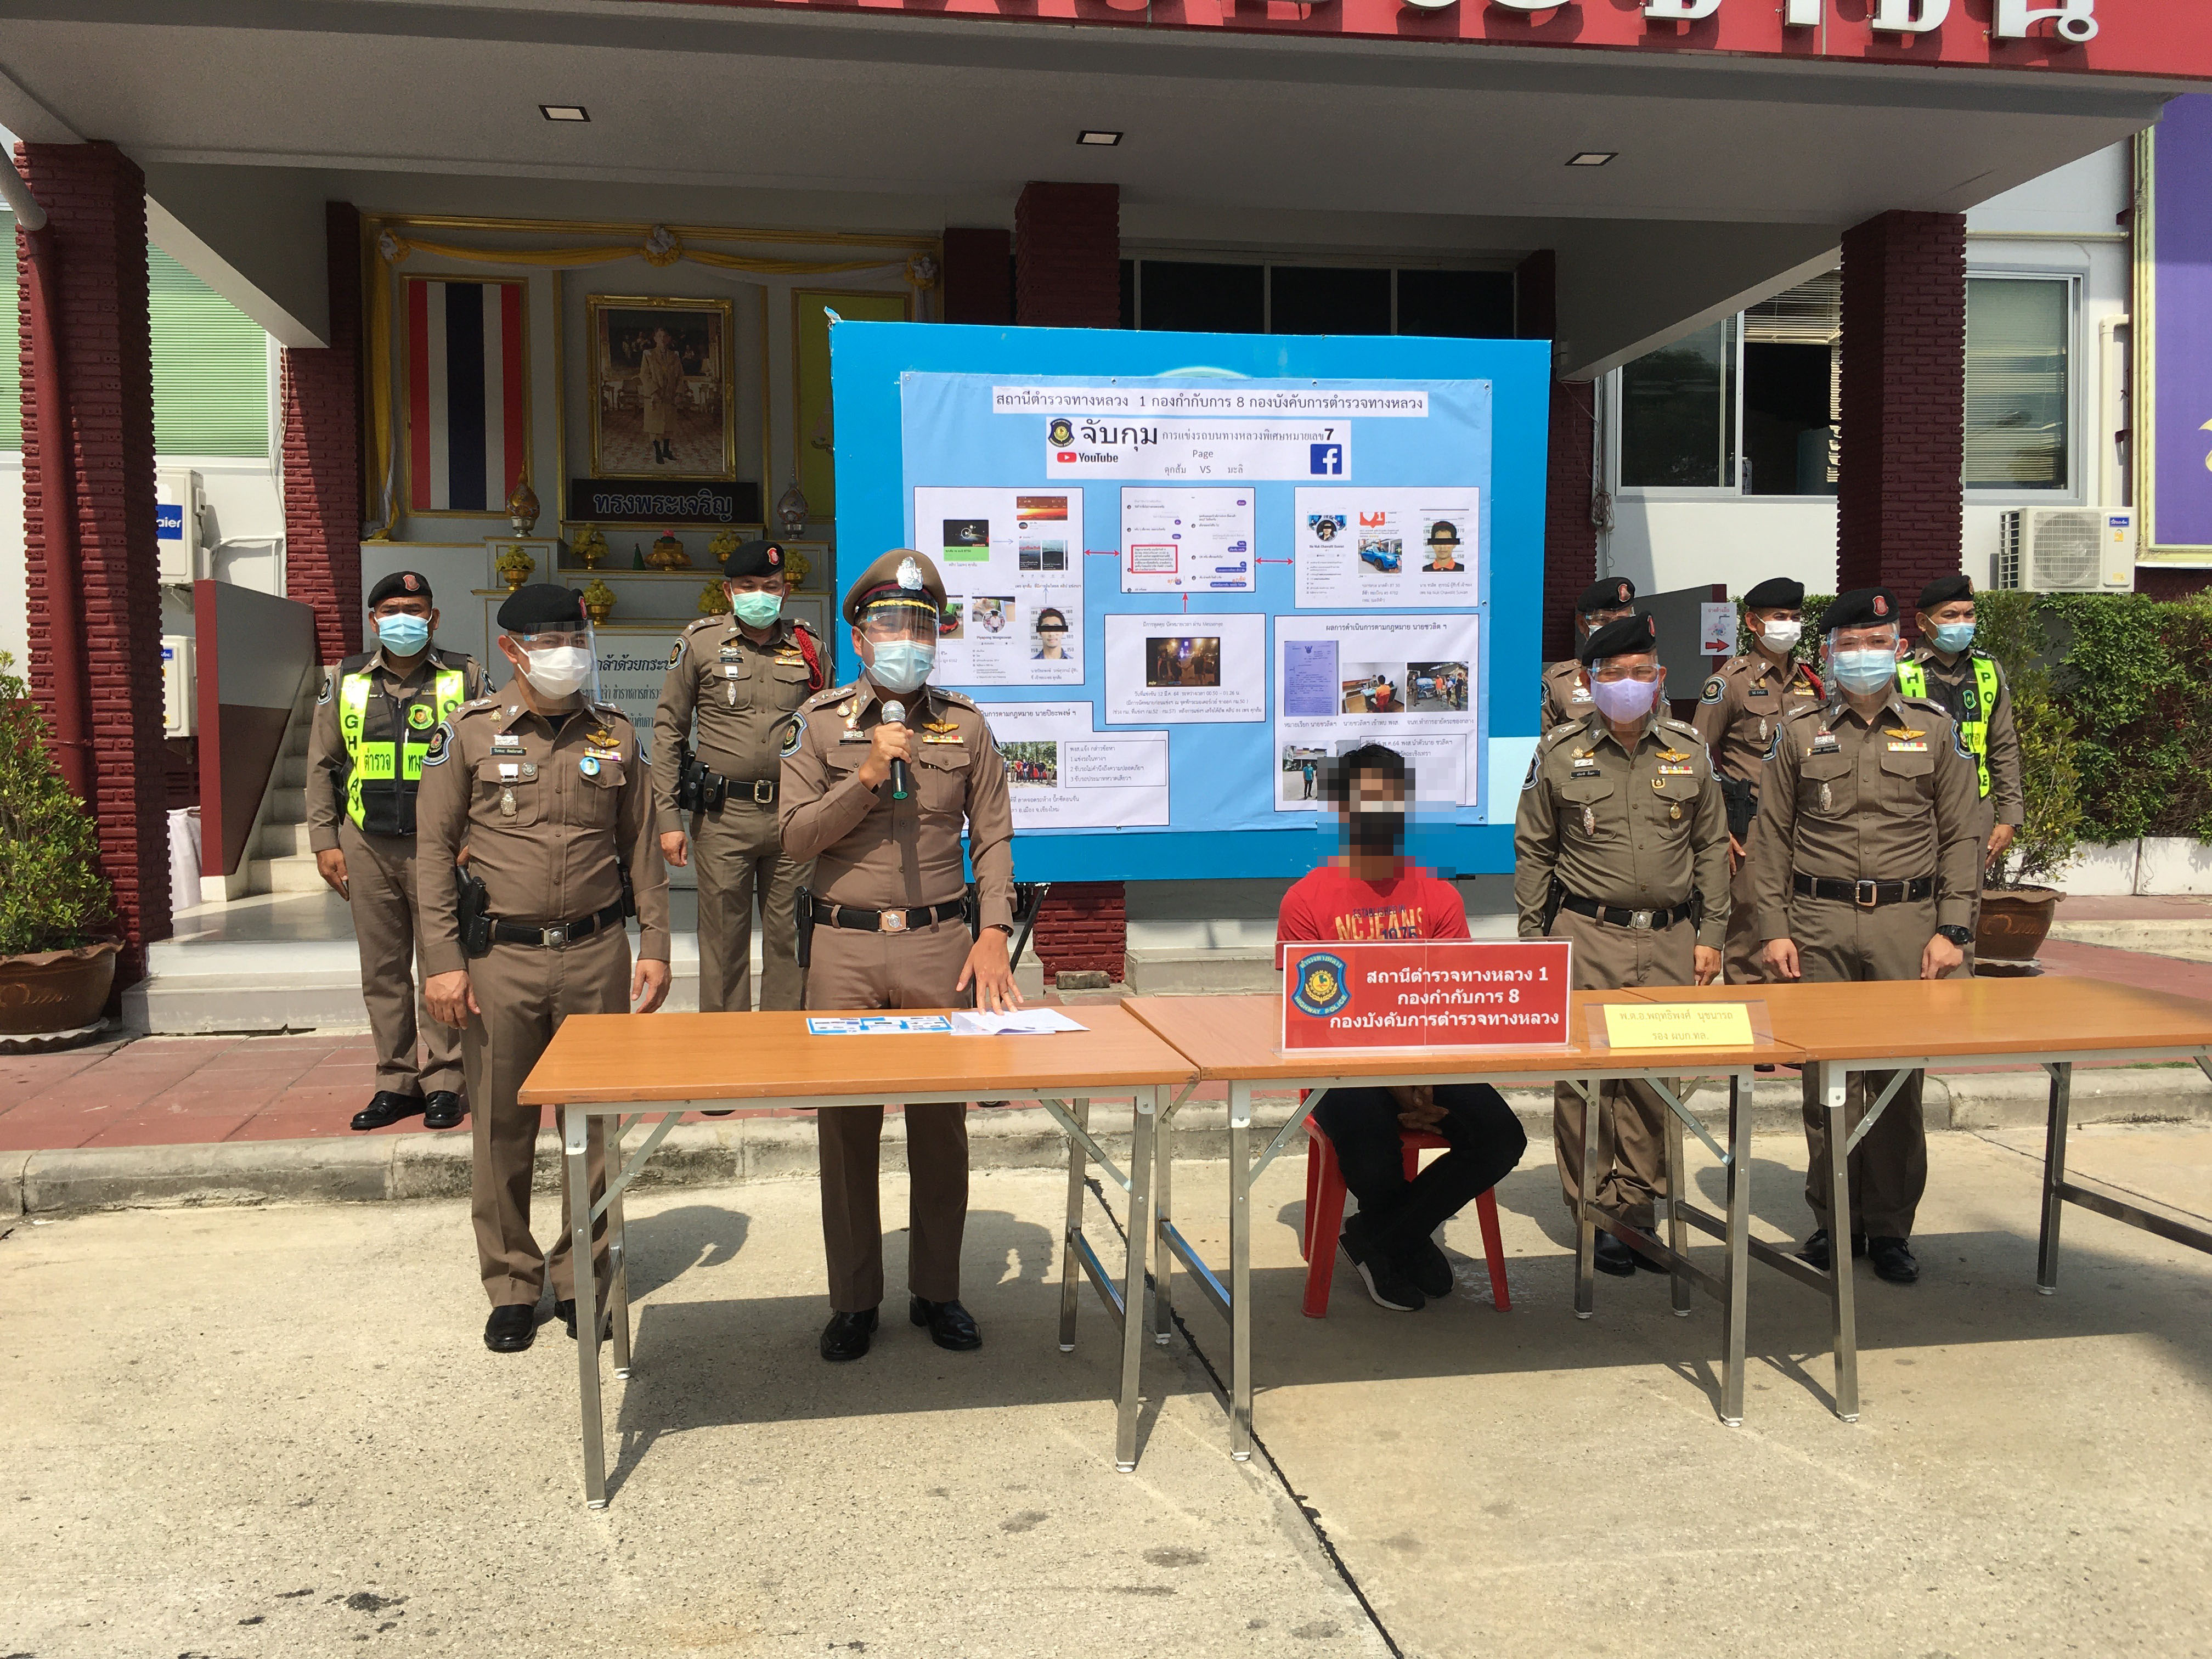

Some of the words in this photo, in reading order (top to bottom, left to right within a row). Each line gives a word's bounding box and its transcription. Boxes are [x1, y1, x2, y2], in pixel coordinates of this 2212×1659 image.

[996, 390, 1128, 407] สถานีตำรวจทางหลวง
[1139, 396, 1146, 407] 1
[1152, 393, 1231, 408] กองกำกับการ
[1237, 397, 1245, 408] 8
[1250, 394, 1423, 409] กองบังคับการตำรวจทางหลวง
[1080, 419, 1158, 452] จับกุม
[1079, 453, 1119, 463] YouTube
[1192, 449, 1214, 460] Page
[1228, 464, 1243, 473] มะลิ
[593, 488, 732, 522] ทรงพระเจริญ
[156, 516, 182, 528] aier
[1325, 623, 1411, 633] ผลการดำเนินการตามกฎหมาย
[364, 747, 391, 771] ตำรวจ
[1366, 967, 1533, 983] สถานีตำรวจทางหลวง
[1538, 967, 1549, 981] 1
[1294, 996, 1320, 1014] HIGHWAY
[1325, 995, 1348, 1014] POLICE
[1397, 989, 1504, 1005] กองกำกับการ
[1508, 989, 1520, 1003] 8
[1330, 1011, 1559, 1028] กองบังคับการตำรวจทางหลวง
[1652, 1032, 1668, 1040] รอง
